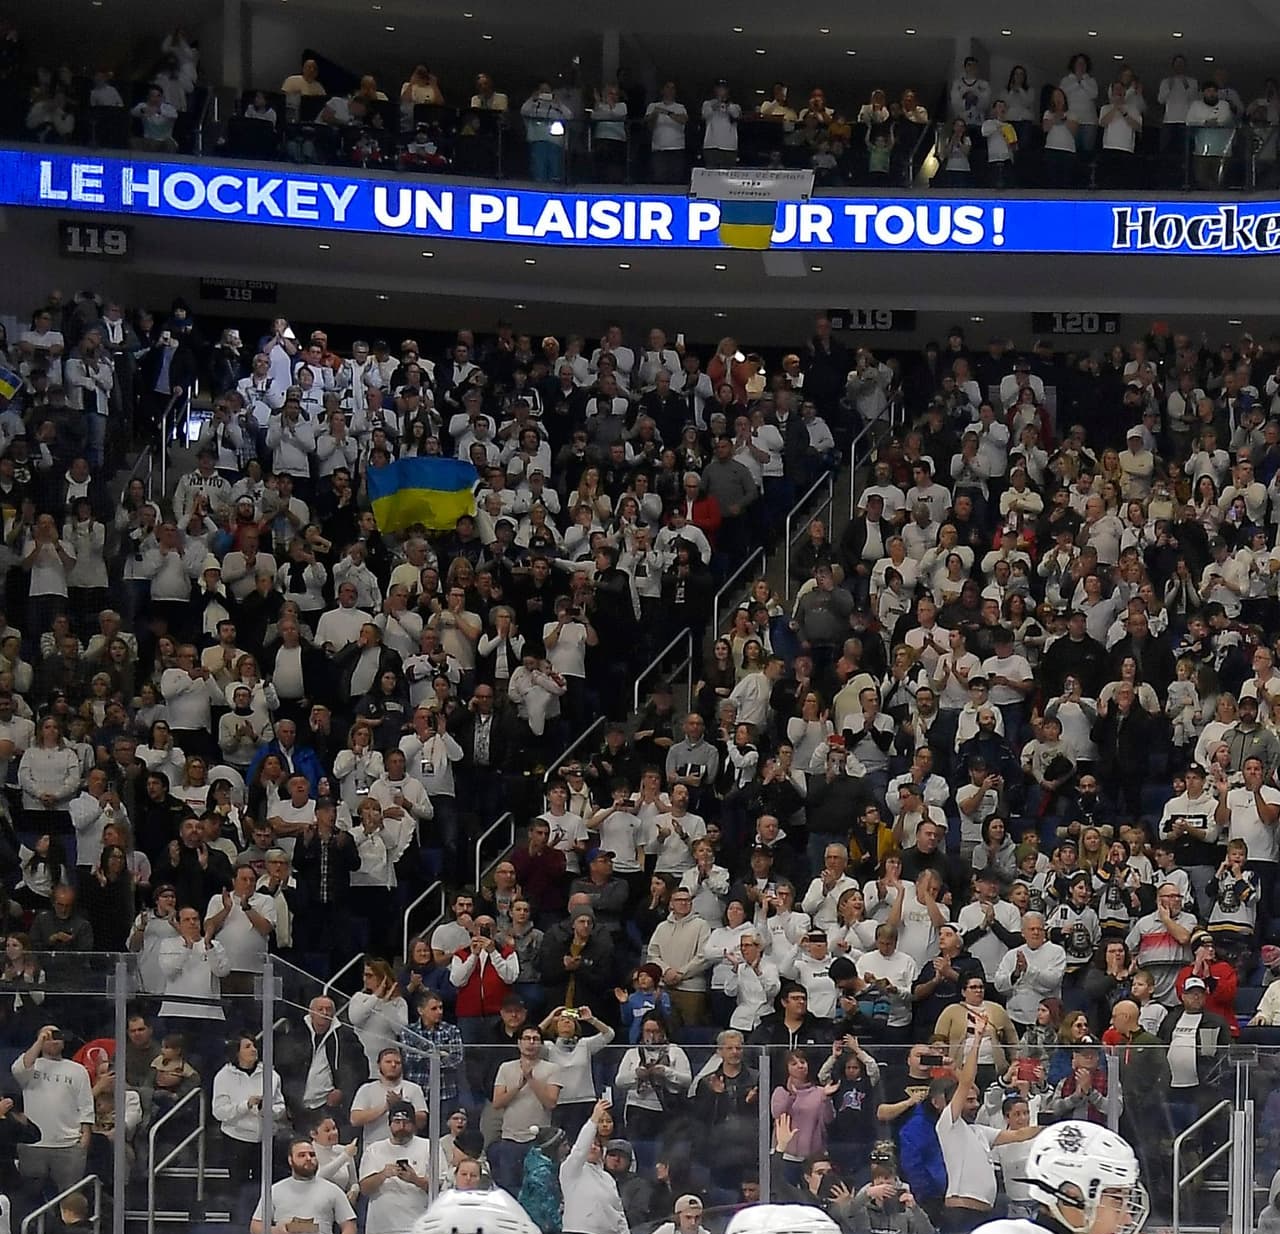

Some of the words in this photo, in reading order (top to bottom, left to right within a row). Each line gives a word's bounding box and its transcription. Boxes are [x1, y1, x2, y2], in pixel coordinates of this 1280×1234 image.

[40, 160, 105, 203] LE
[122, 167, 358, 222] HOCKEY
[373, 187, 453, 231] UN
[470, 193, 673, 241] PLAISIR
[688, 202, 834, 243] PUR
[67, 227, 127, 255] 119
[225, 288, 252, 300] 119
[849, 311, 892, 330] 119
[1053, 313, 1101, 334] 120
